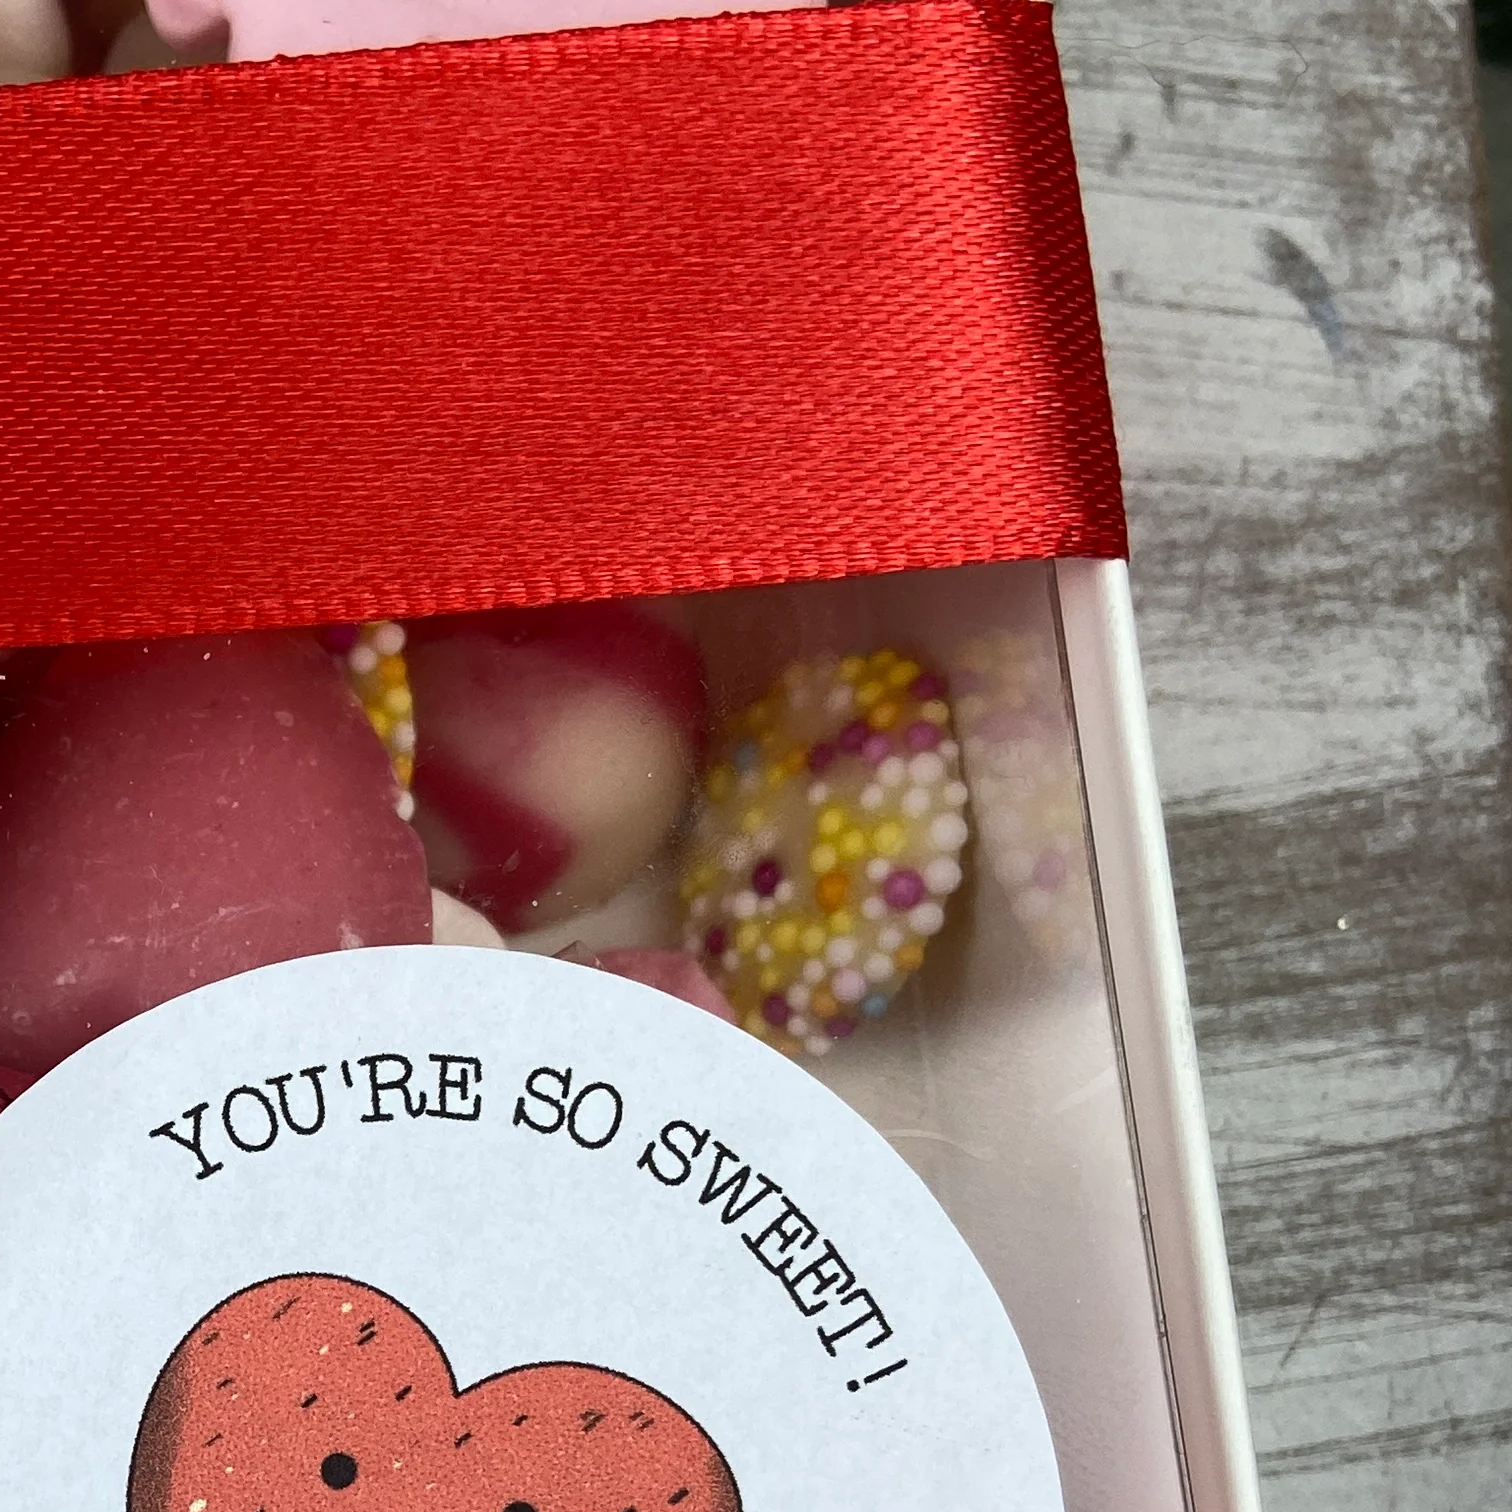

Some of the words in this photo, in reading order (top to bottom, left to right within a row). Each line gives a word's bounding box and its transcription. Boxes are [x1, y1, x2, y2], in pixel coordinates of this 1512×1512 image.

[149, 1053, 483, 1180] YOU'RE
[513, 1066, 624, 1150] SO
[637, 1119, 909, 1393] SWEET!
